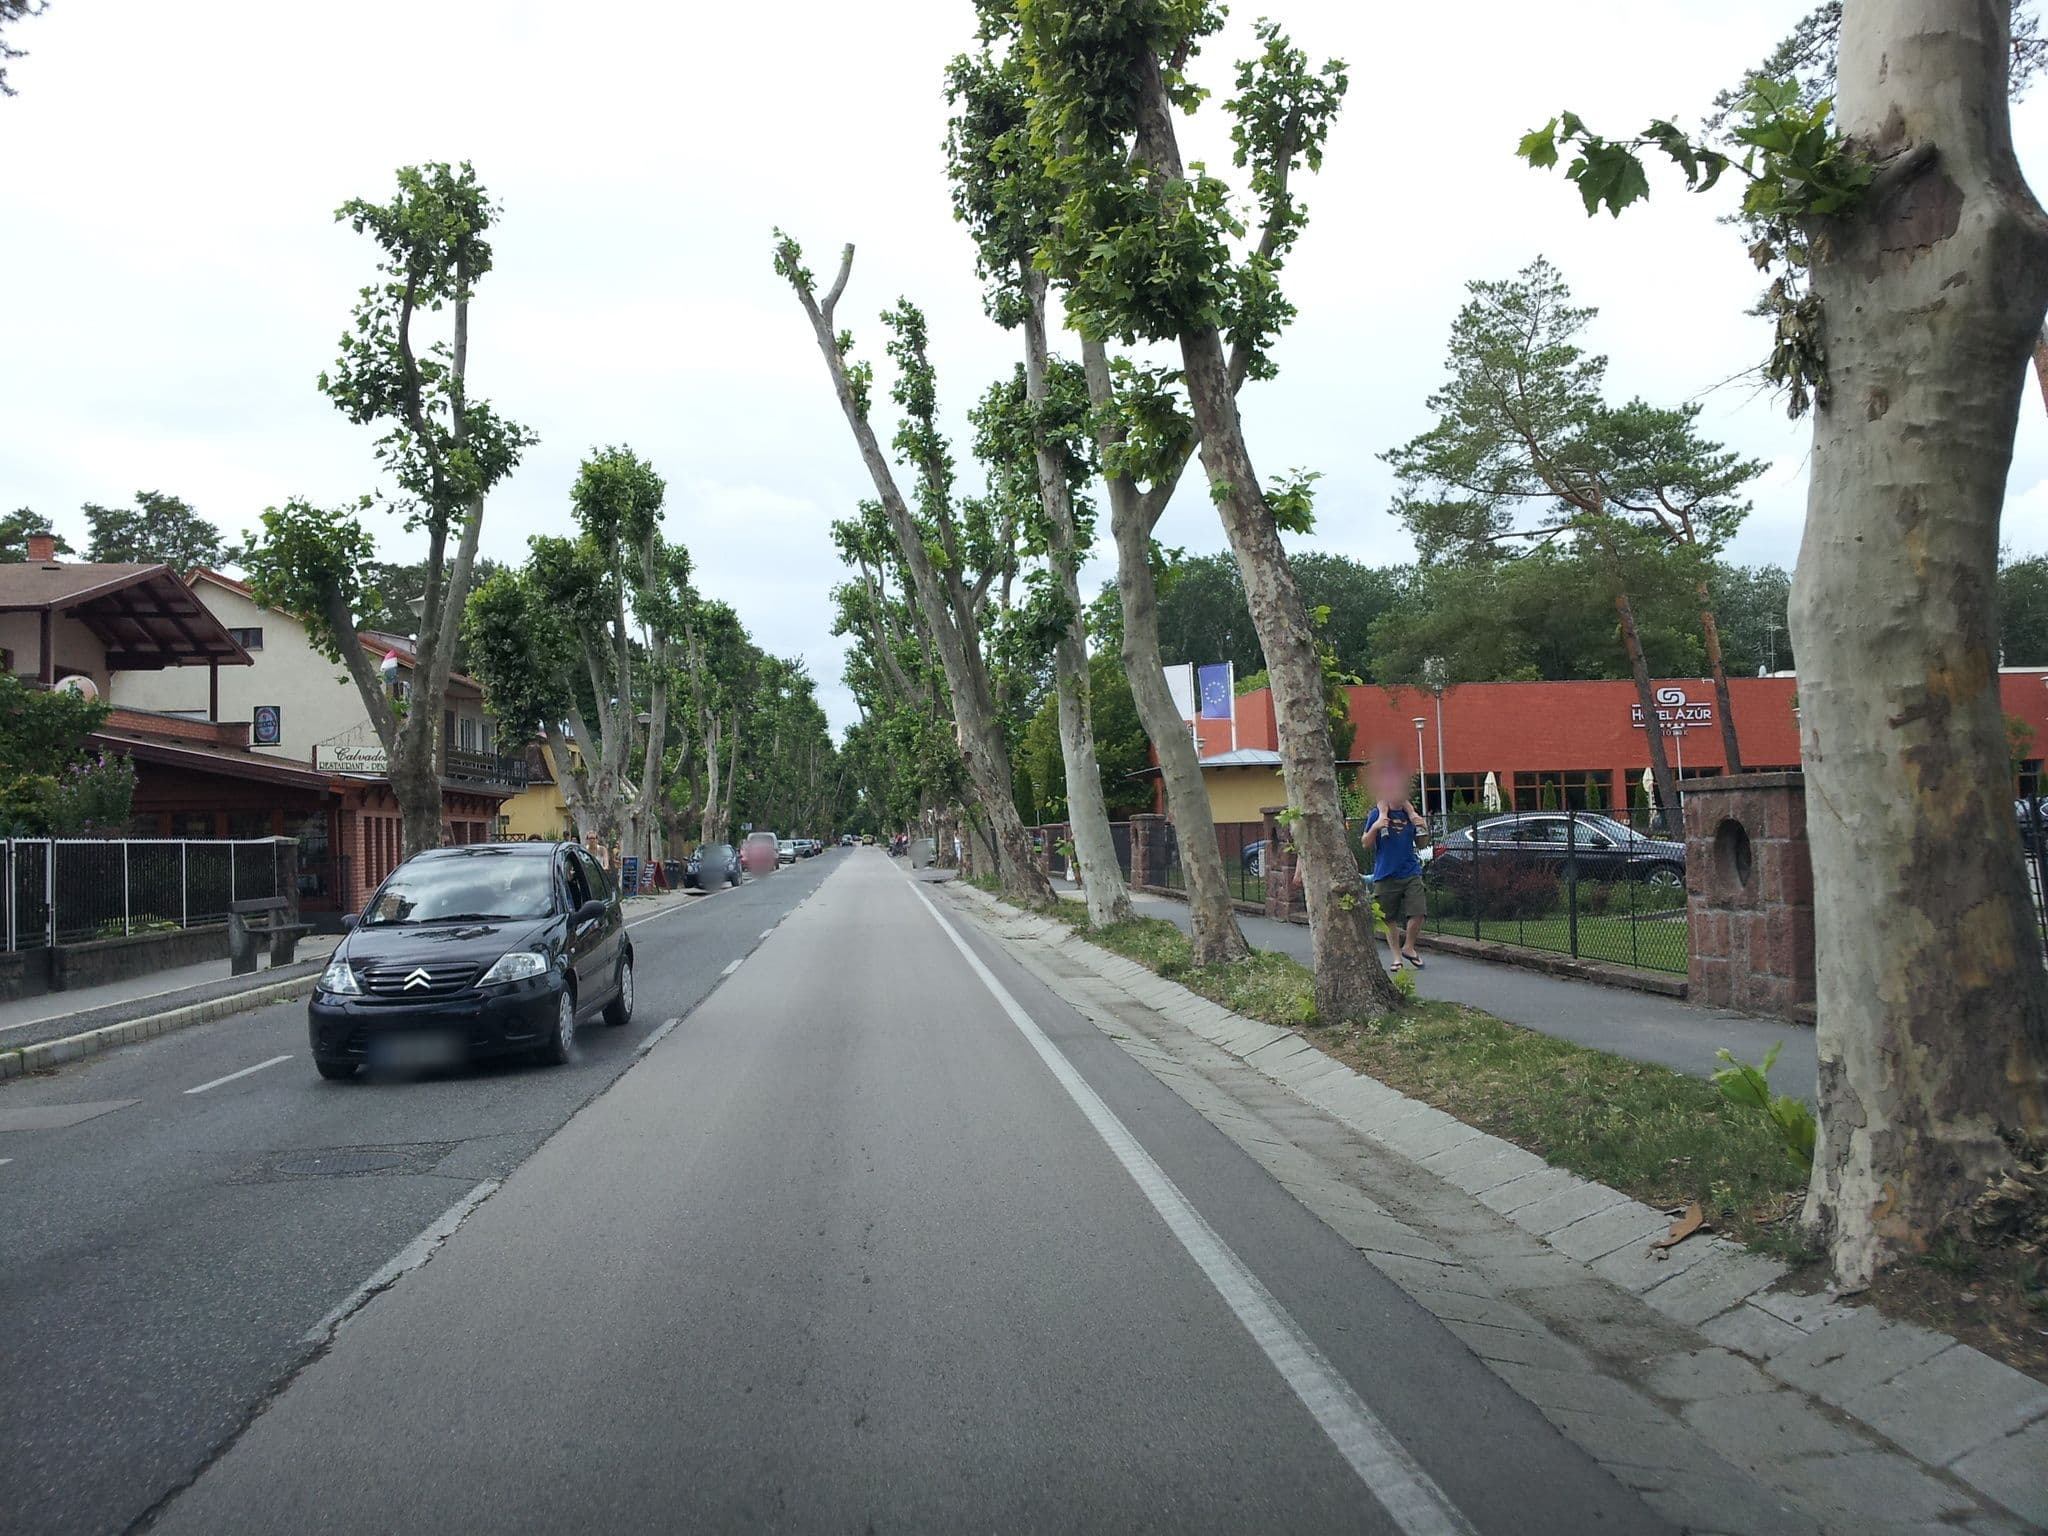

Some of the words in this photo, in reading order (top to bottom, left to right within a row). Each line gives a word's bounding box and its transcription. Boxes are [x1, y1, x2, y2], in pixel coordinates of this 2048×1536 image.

[1632, 709, 1673, 721] HTEL
[1675, 707, 1712, 720] AZÚR
[334, 746, 388, 762] Calvado
[319, 761, 365, 770] RESTAURANT
